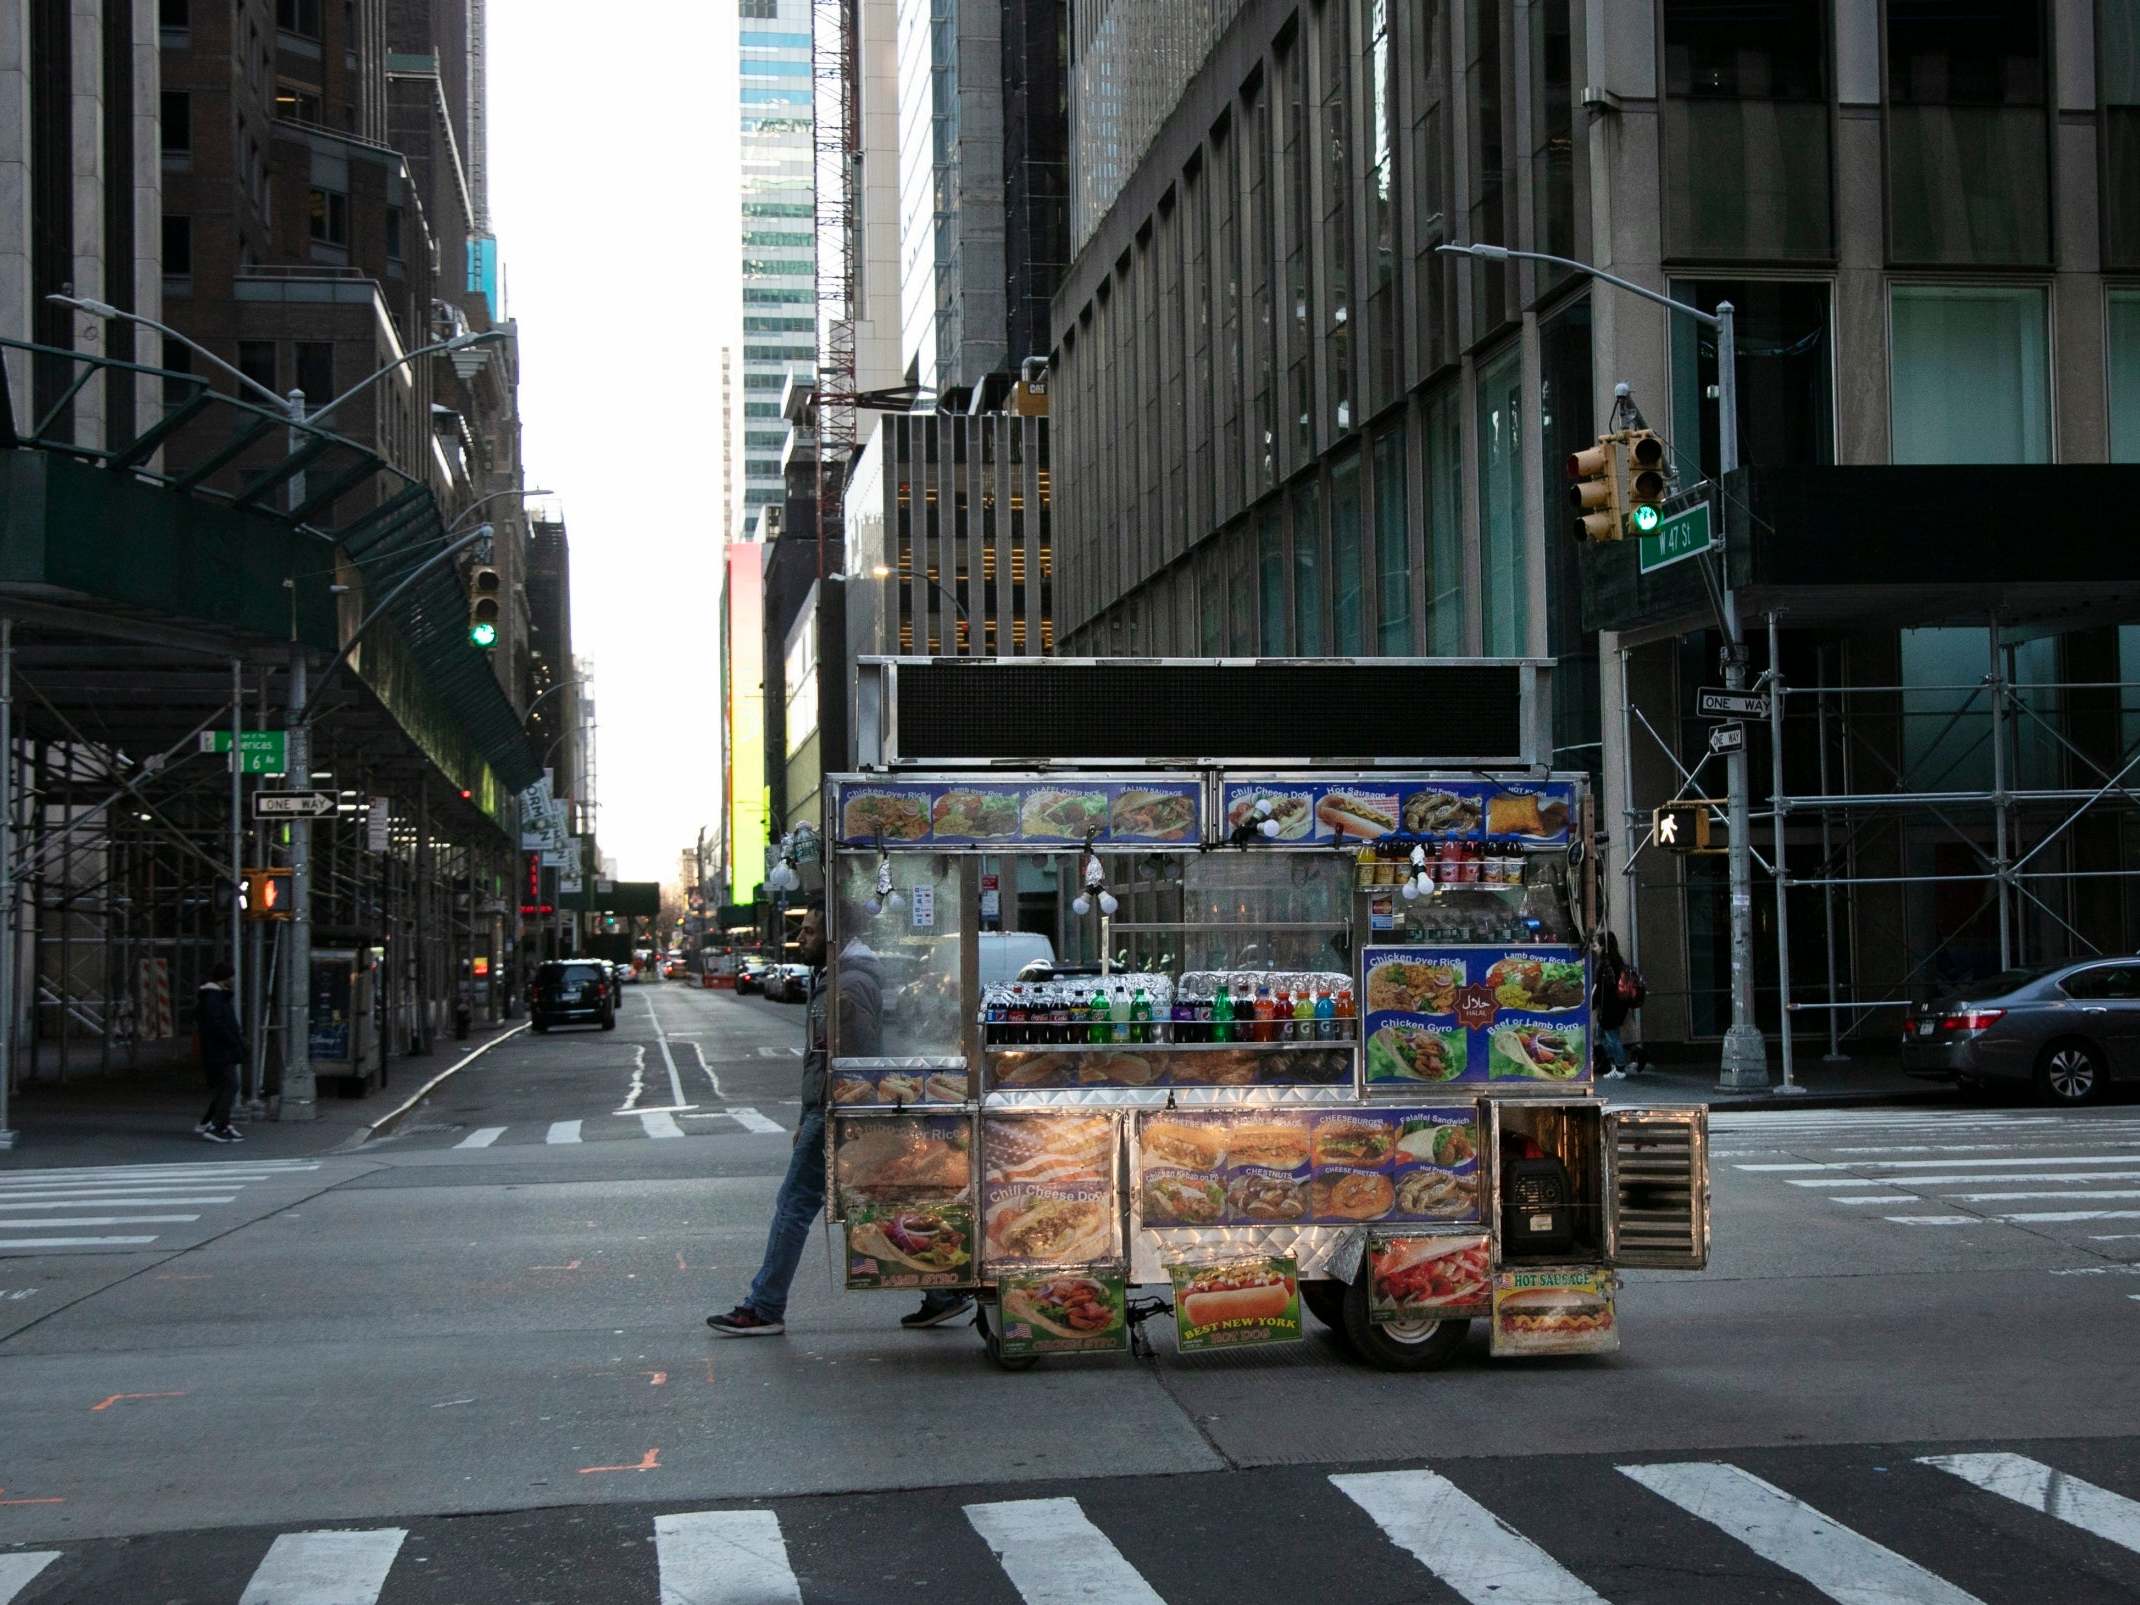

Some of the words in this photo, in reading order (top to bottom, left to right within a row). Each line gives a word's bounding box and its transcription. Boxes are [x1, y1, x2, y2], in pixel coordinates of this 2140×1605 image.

[1658, 535, 1667, 555] W
[1668, 529, 1679, 551] 47
[1681, 522, 1691, 546] St
[1706, 696, 1730, 709] ONE
[1744, 698, 1771, 711] WAY
[226, 740, 273, 750] Aericas
[1713, 735, 1724, 746] ONE
[1729, 732, 1740, 743] WAY
[252, 755, 260, 770] 6
[846, 785, 885, 800] Chicken
[887, 790, 905, 800] over
[1120, 786, 1149, 794] ITALIAN
[1150, 787, 1184, 797] SAUSAGE
[1230, 785, 1253, 800] Chili
[1255, 786, 1289, 799] Cheese
[1327, 786, 1345, 795] Hot
[1347, 786, 1387, 800] Sausage
[1508, 786, 1524, 794] HOT
[267, 799, 292, 810] ONE
[301, 799, 326, 809] WAY
[1369, 952, 1413, 968] Chicken
[1414, 956, 1439, 967] over
[1439, 956, 1461, 967] Rice
[1504, 951, 1528, 960] Lamb
[1529, 954, 1548, 962] over
[1548, 956, 1566, 964] Rice
[1466, 1009, 1487, 1017] HALAL
[1284, 1022, 1294, 1034] G
[1300, 1022, 1310, 1034] G
[1320, 1021, 1330, 1032] G
[1380, 1019, 1425, 1032] Chicken
[1426, 1022, 1453, 1033] Gyro
[1486, 1018, 1510, 1036] Beef
[1512, 1018, 1524, 1026] or
[1525, 1017, 1554, 1031] Lamb
[1555, 1021, 1580, 1033] Gyro
[1319, 1114, 1384, 1128] CHEESEBURGER
[1431, 1115, 1470, 1126] Sandwich
[1245, 1168, 1293, 1179] CHESTNUTS
[1353, 1168, 1381, 1177] PRETZEL
[989, 1184, 1021, 1202] Chili
[1025, 1184, 1075, 1201] Cheese
[1514, 1273, 1537, 1288] HOT
[1538, 1273, 1591, 1287] SAUSAGE
[1183, 1322, 1219, 1340] BEST
[1222, 1317, 1254, 1329] NEW
[1258, 1317, 1297, 1329] YORK
